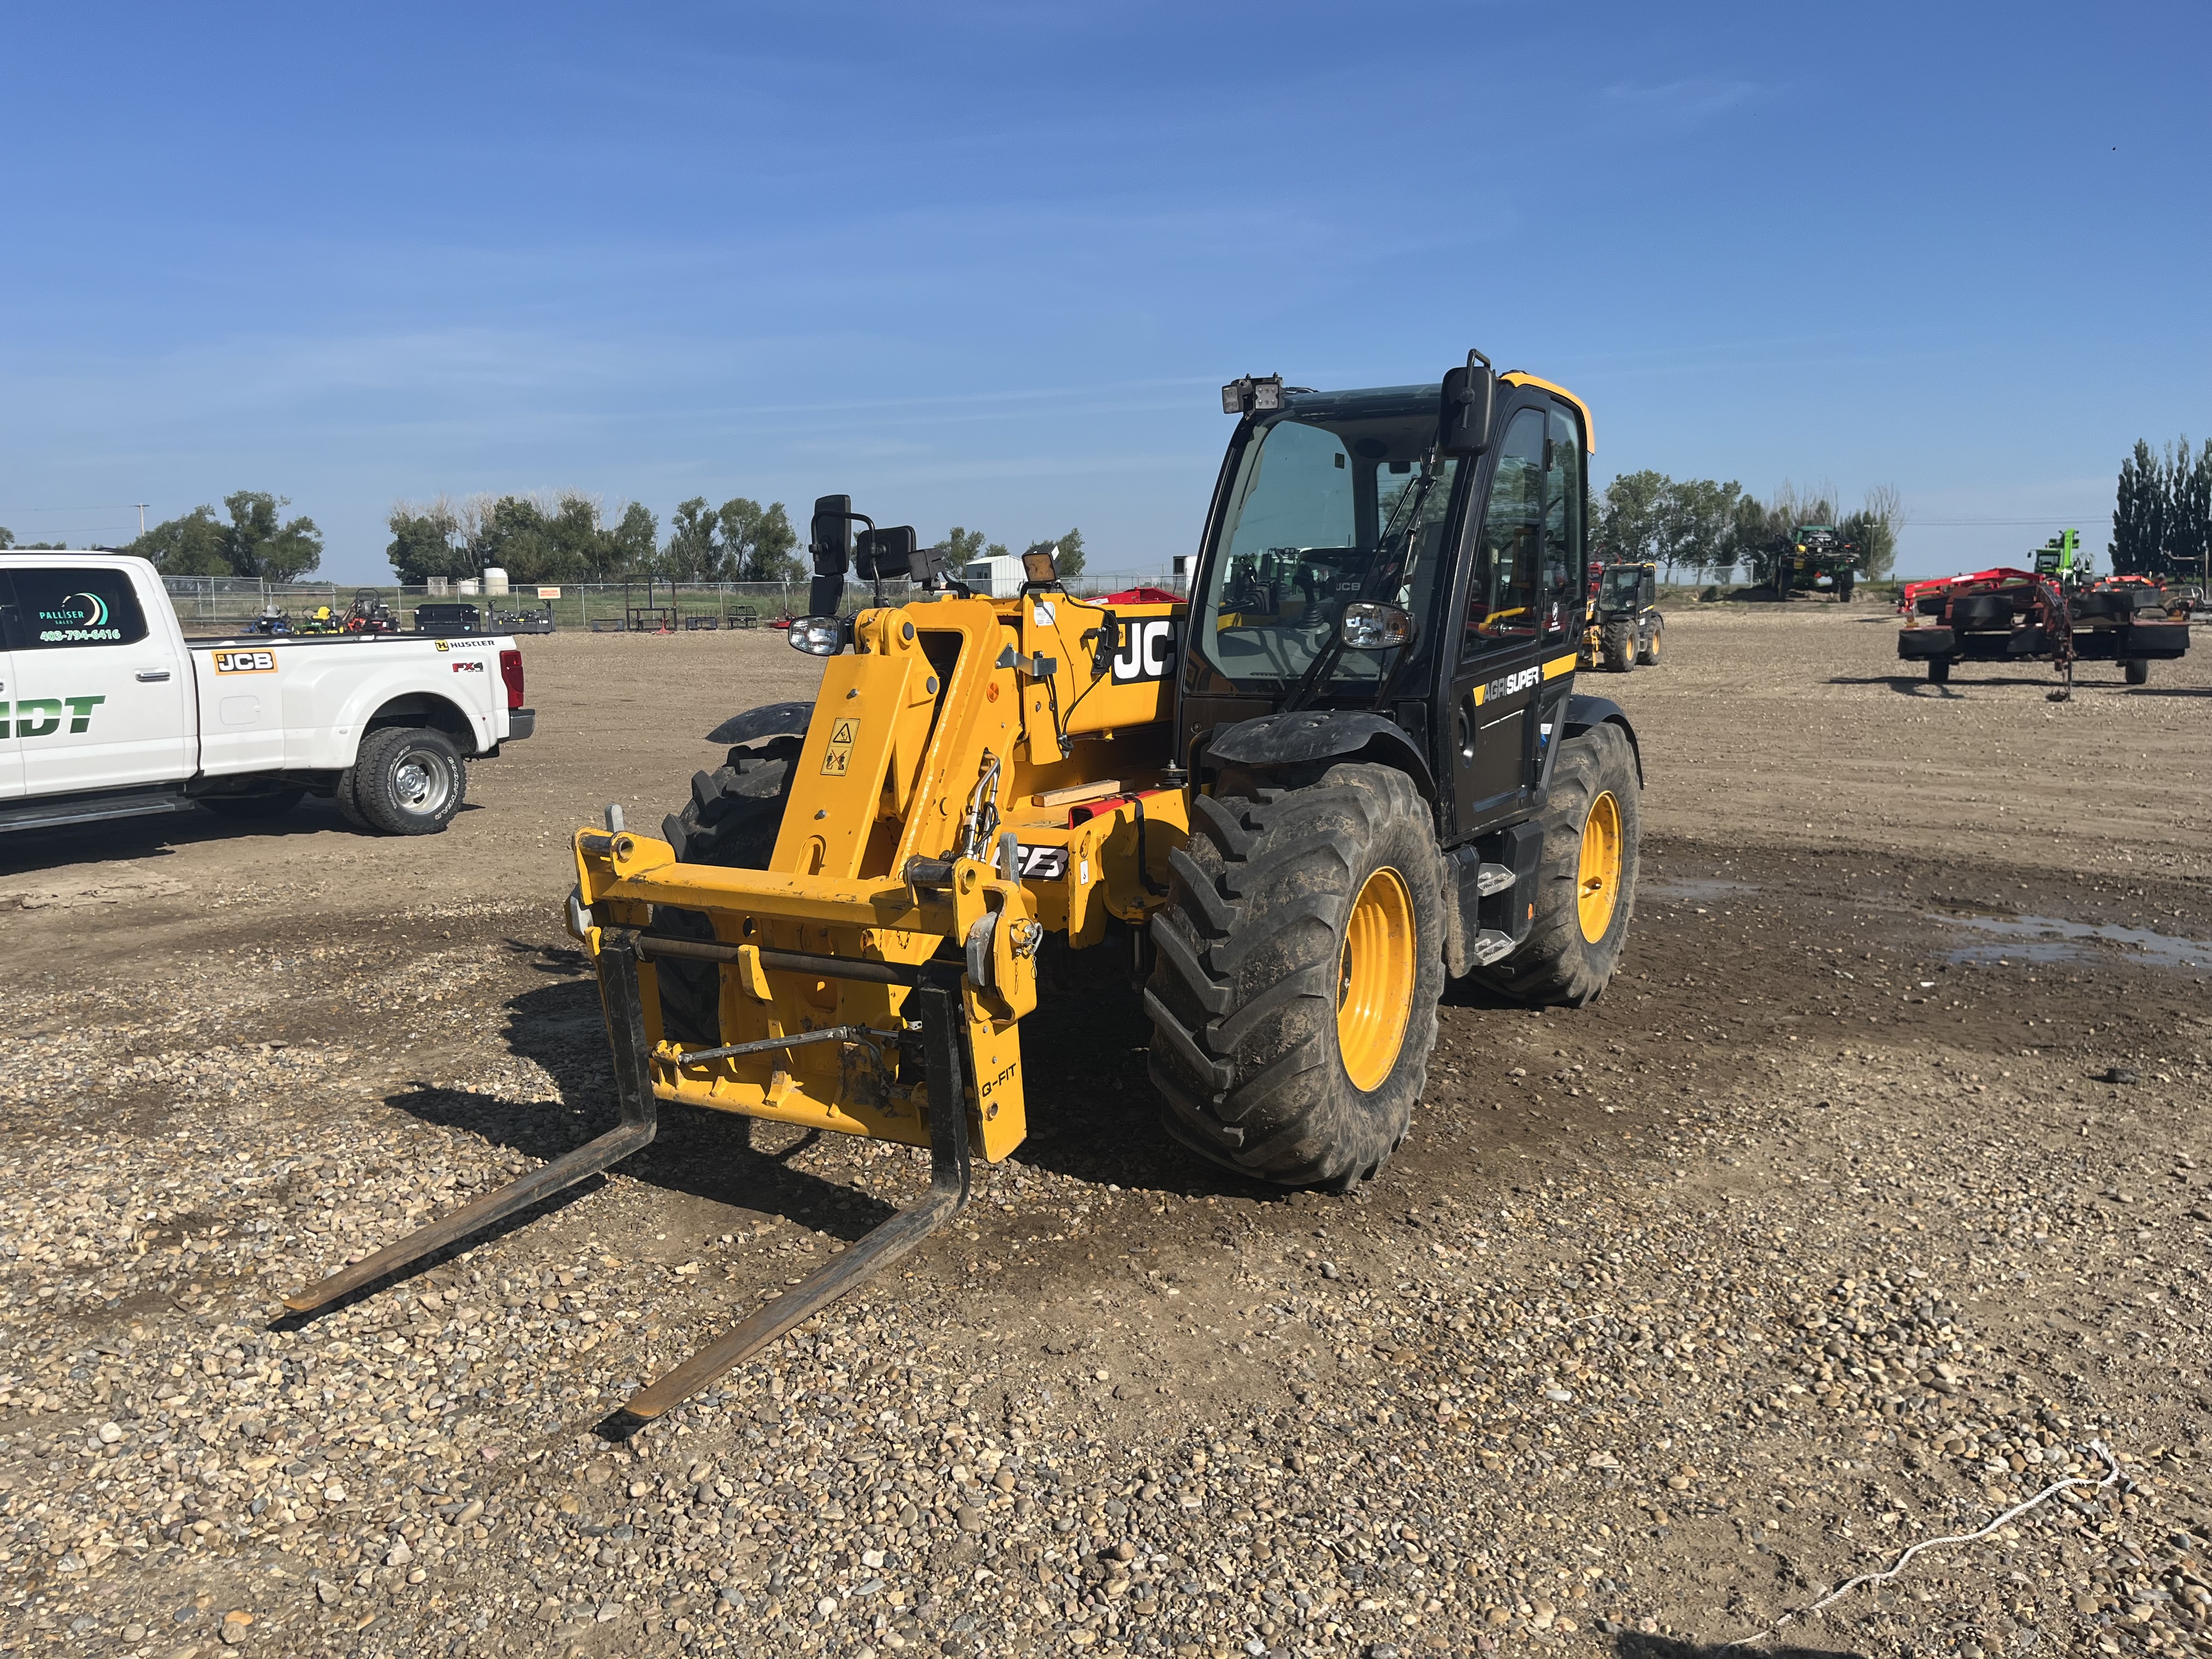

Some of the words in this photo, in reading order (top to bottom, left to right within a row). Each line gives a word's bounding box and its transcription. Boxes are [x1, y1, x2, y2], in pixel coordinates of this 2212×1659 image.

[1336, 583, 1361, 591] JCB
[39, 609, 84, 619] PALLISER
[40, 629, 121, 641] 403-794-6416
[1114, 621, 1184, 679] JC
[218, 653, 273, 671] JCB
[453, 662, 484, 673] FX4
[387, 746, 410, 809] WRANGLER
[435, 757, 459, 820] GOODYEAR
[981, 1062, 1017, 1098] Q-FIT
